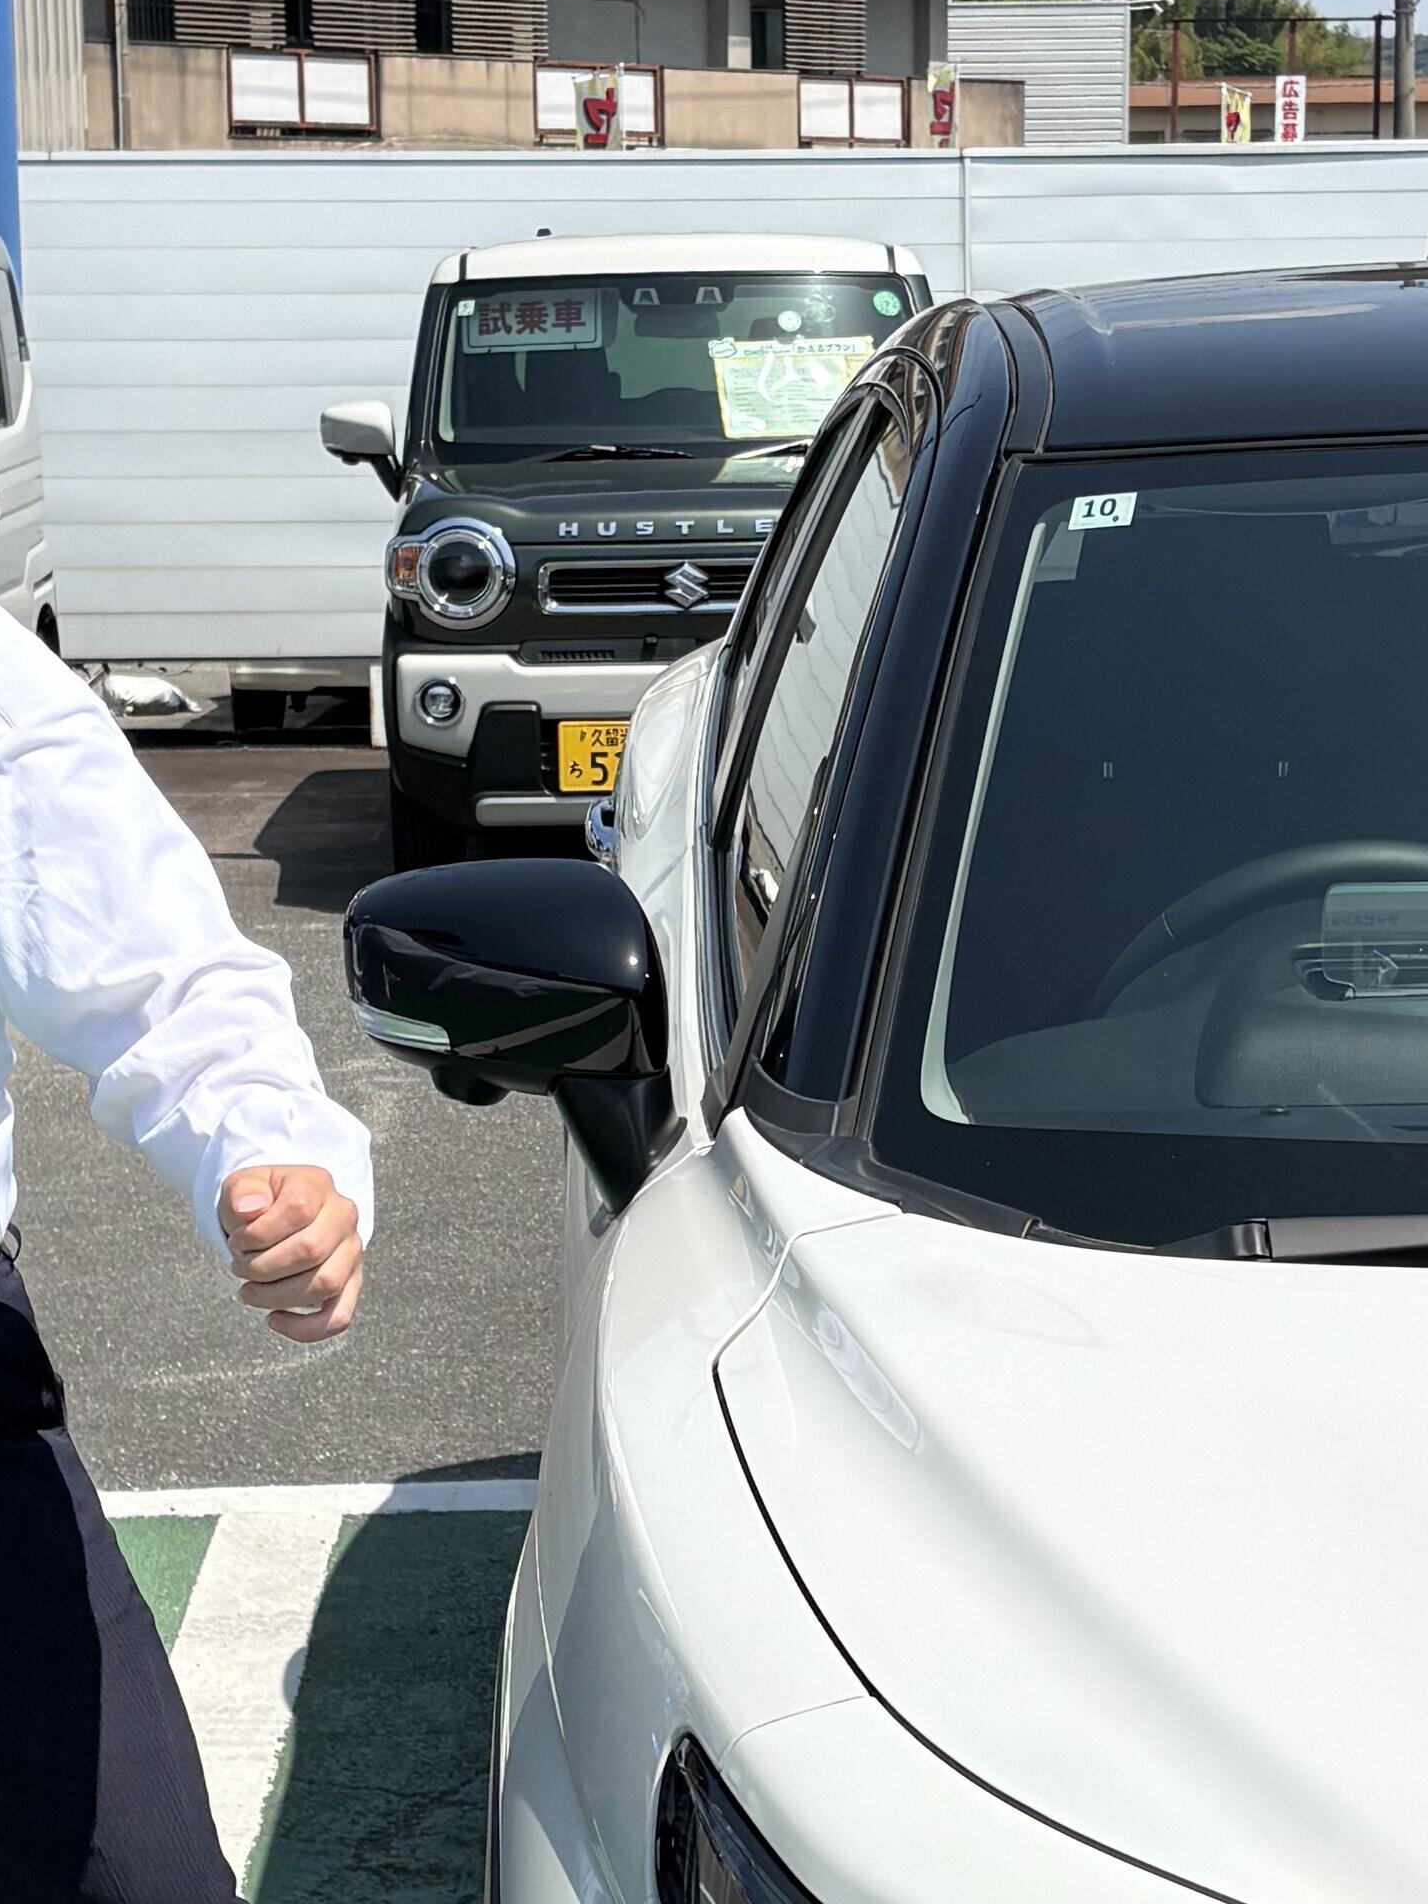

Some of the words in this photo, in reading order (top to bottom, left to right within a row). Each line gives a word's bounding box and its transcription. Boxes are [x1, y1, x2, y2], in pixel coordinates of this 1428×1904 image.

[477, 299, 587, 336] 試乗車
[1081, 497, 1117, 518] 10
[590, 751, 623, 786] 5
